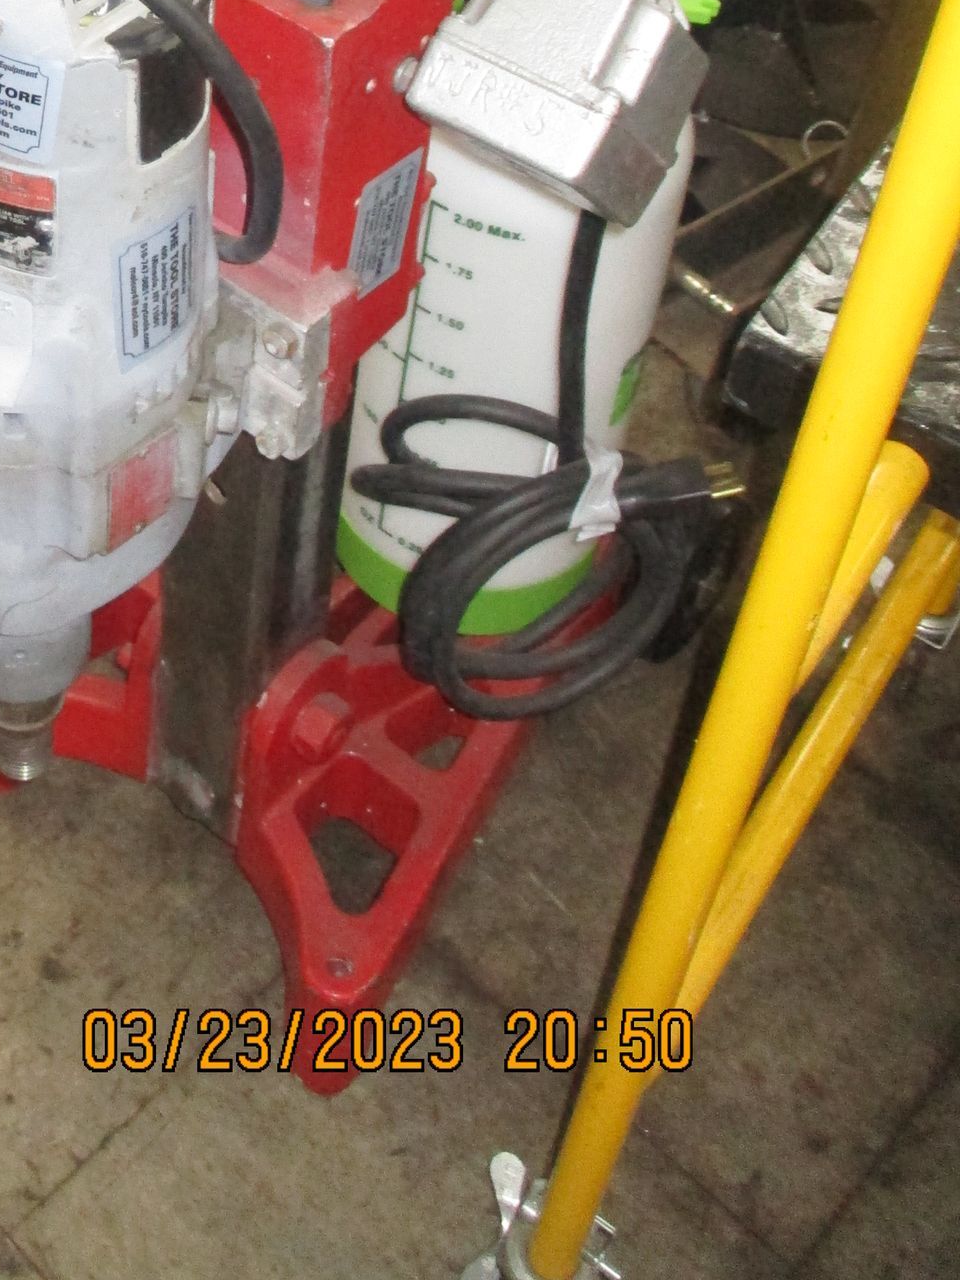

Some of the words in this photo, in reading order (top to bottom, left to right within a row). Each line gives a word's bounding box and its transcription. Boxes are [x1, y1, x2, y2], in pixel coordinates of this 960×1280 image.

[170, 223, 179, 251] THE
[454, 213, 483, 231] 2.00
[488, 224, 525, 241] Max.
[170, 252, 179, 288] TOOL
[446, 262, 473, 280] 1.75
[438, 313, 464, 331] 1.50
[429, 361, 455, 378] 1.25
